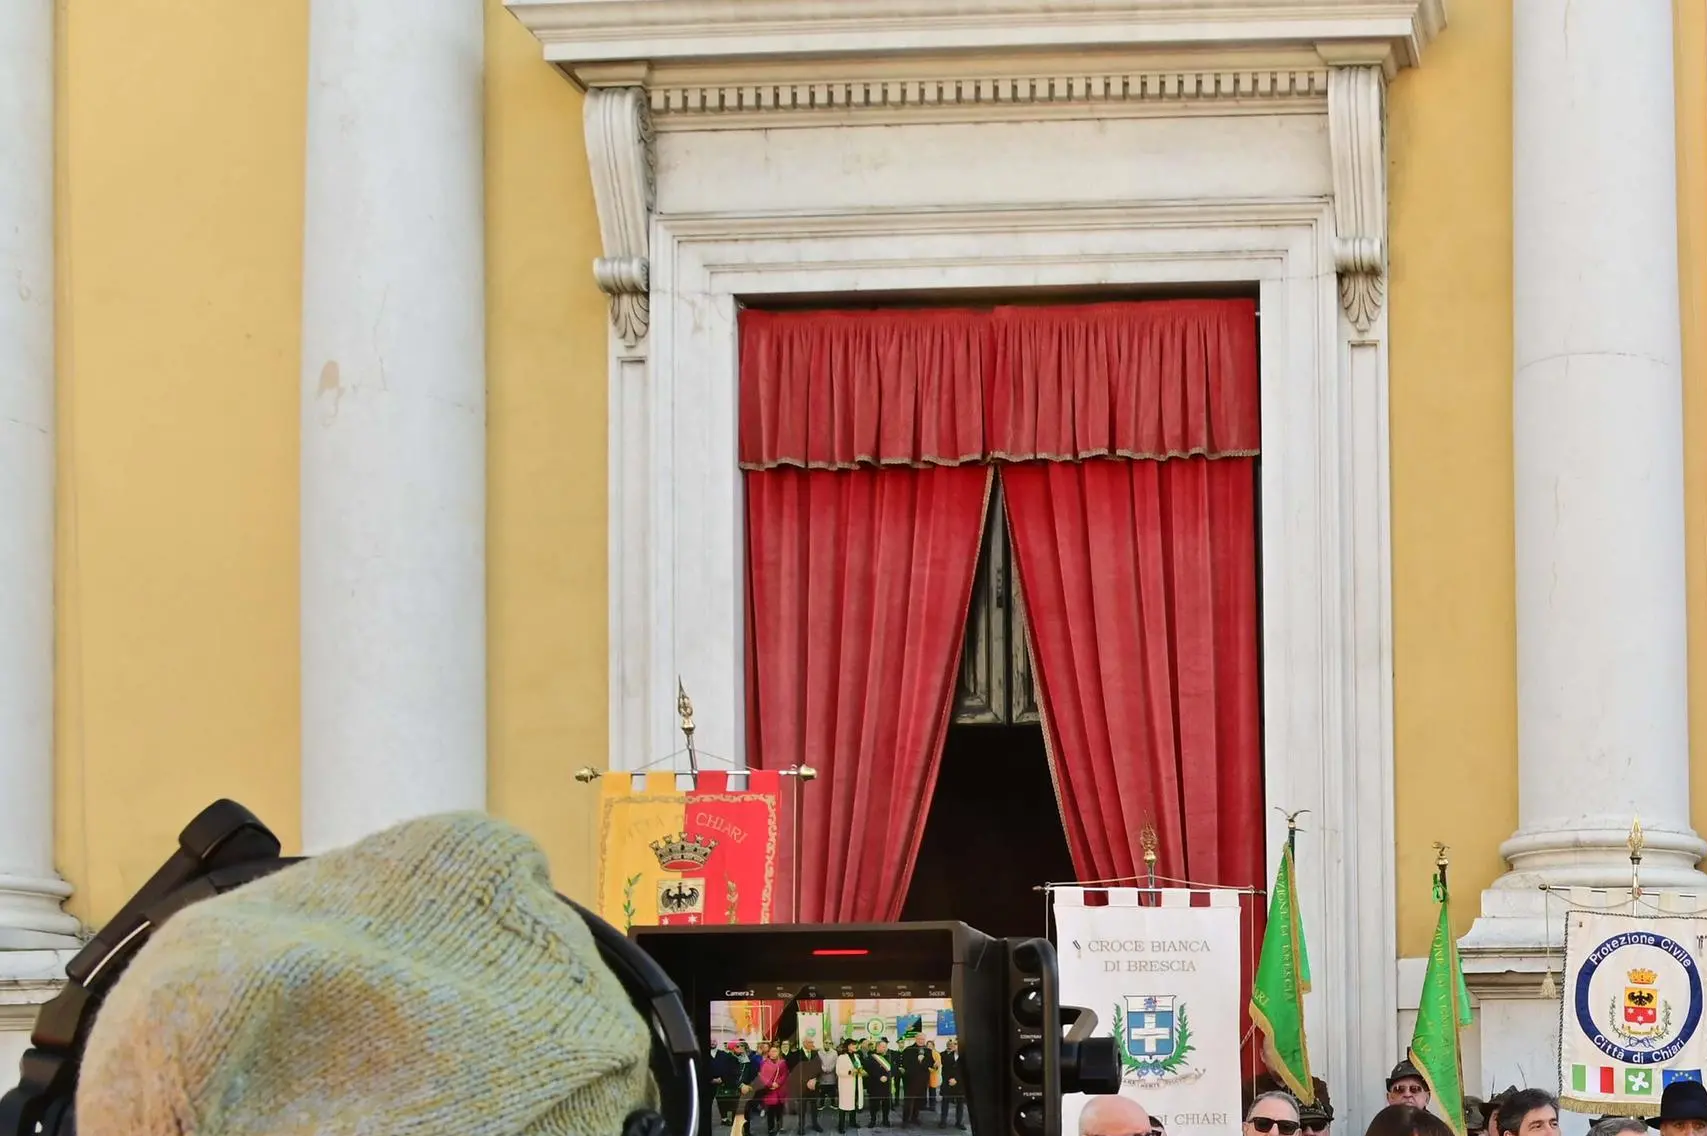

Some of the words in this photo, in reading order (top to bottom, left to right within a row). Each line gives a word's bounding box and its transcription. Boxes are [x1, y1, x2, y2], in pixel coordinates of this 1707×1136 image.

[696, 812, 748, 843] CHIARI
[1087, 939, 1145, 953] CROCE
[1151, 939, 1211, 953] BIANCA
[1589, 934, 1655, 966] Protezione
[1661, 939, 1692, 968] Civile
[1103, 960, 1121, 973] DI
[1127, 960, 1197, 973] BRESCIA
[725, 989, 749, 997] Camera
[750, 989, 755, 997] 2
[1593, 1033, 1625, 1061] Città
[1632, 1052, 1644, 1064] di
[1652, 1038, 1685, 1062] Chiari
[1174, 1112, 1228, 1126] CHIARI
